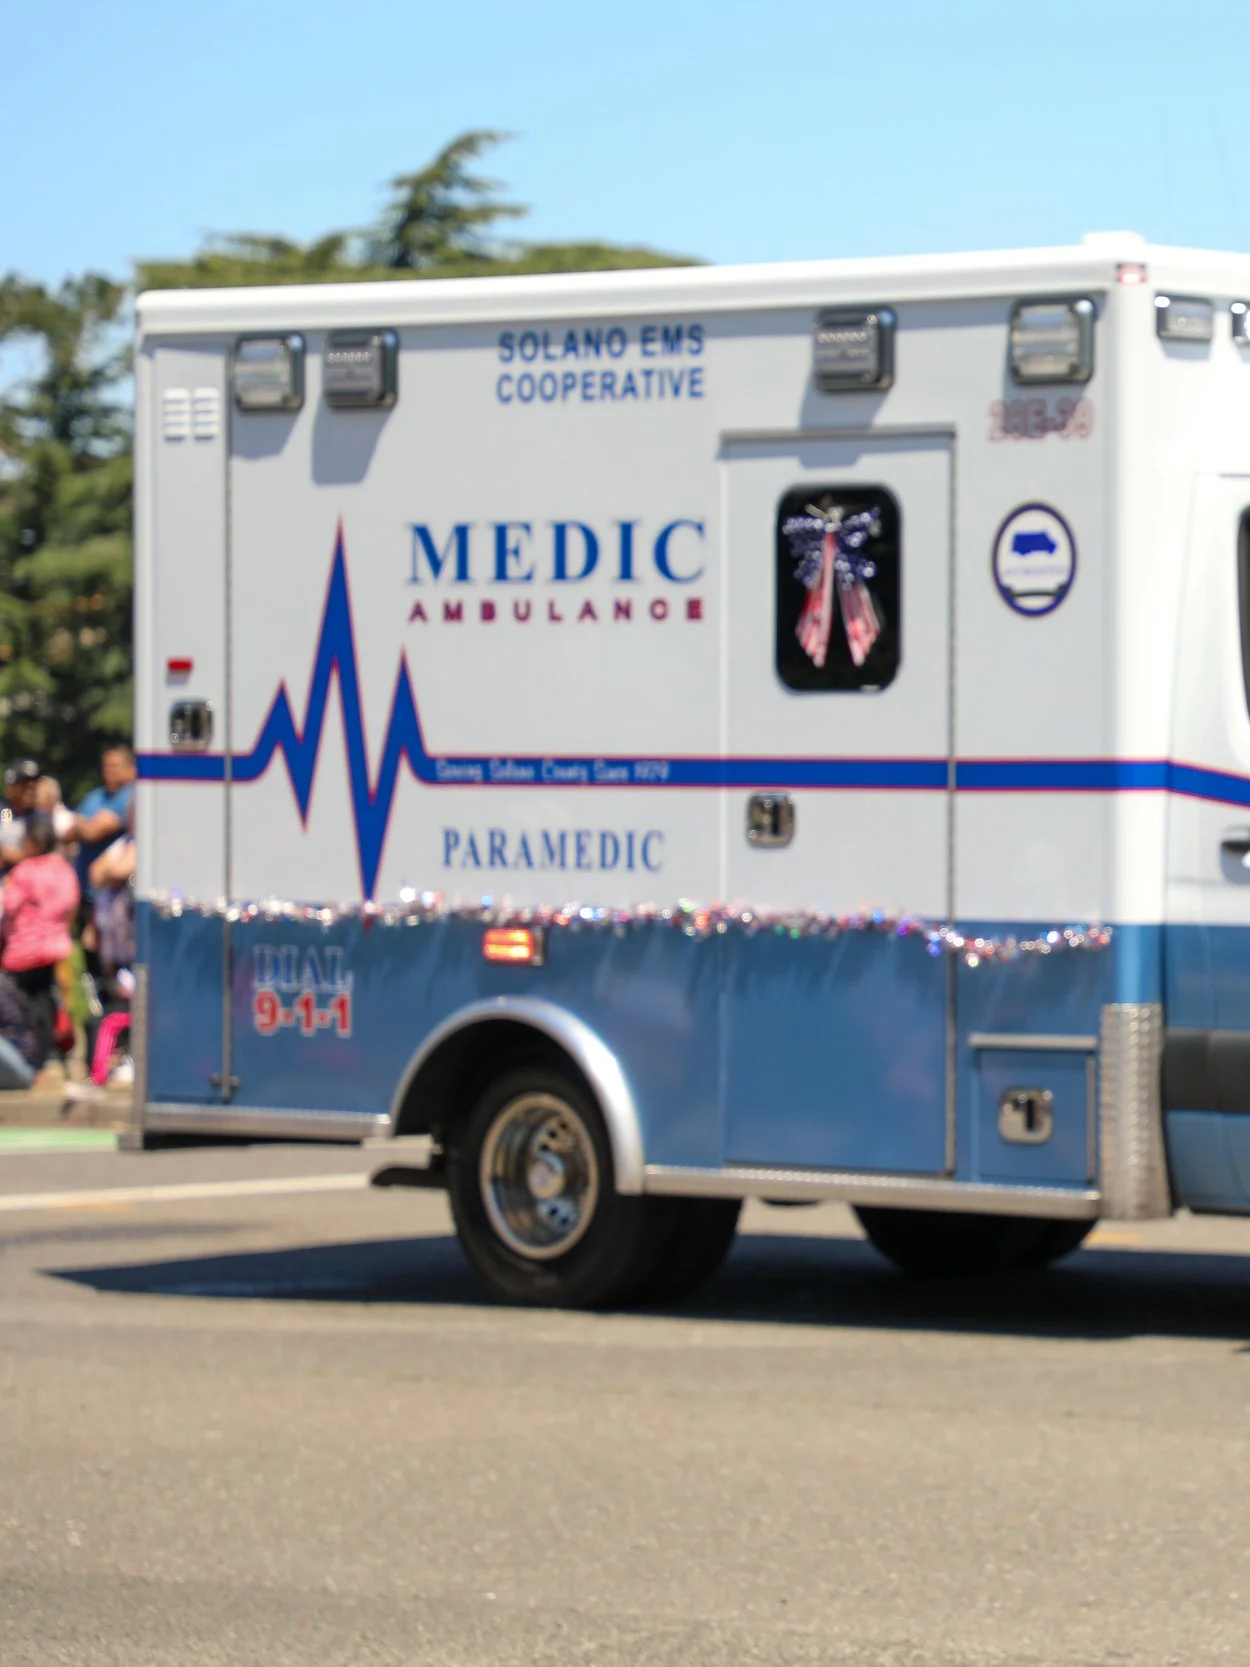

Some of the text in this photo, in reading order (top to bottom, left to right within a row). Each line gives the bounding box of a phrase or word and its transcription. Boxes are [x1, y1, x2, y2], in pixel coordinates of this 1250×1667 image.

[498, 323, 704, 364] SOLANO EMS
[496, 366, 704, 404] COOPERATIVE
[407, 518, 706, 584] MEDIC
[408, 598, 704, 623] AMBULANCE
[442, 828, 665, 873] PARAMEDIC
[253, 944, 354, 993] DIAL
